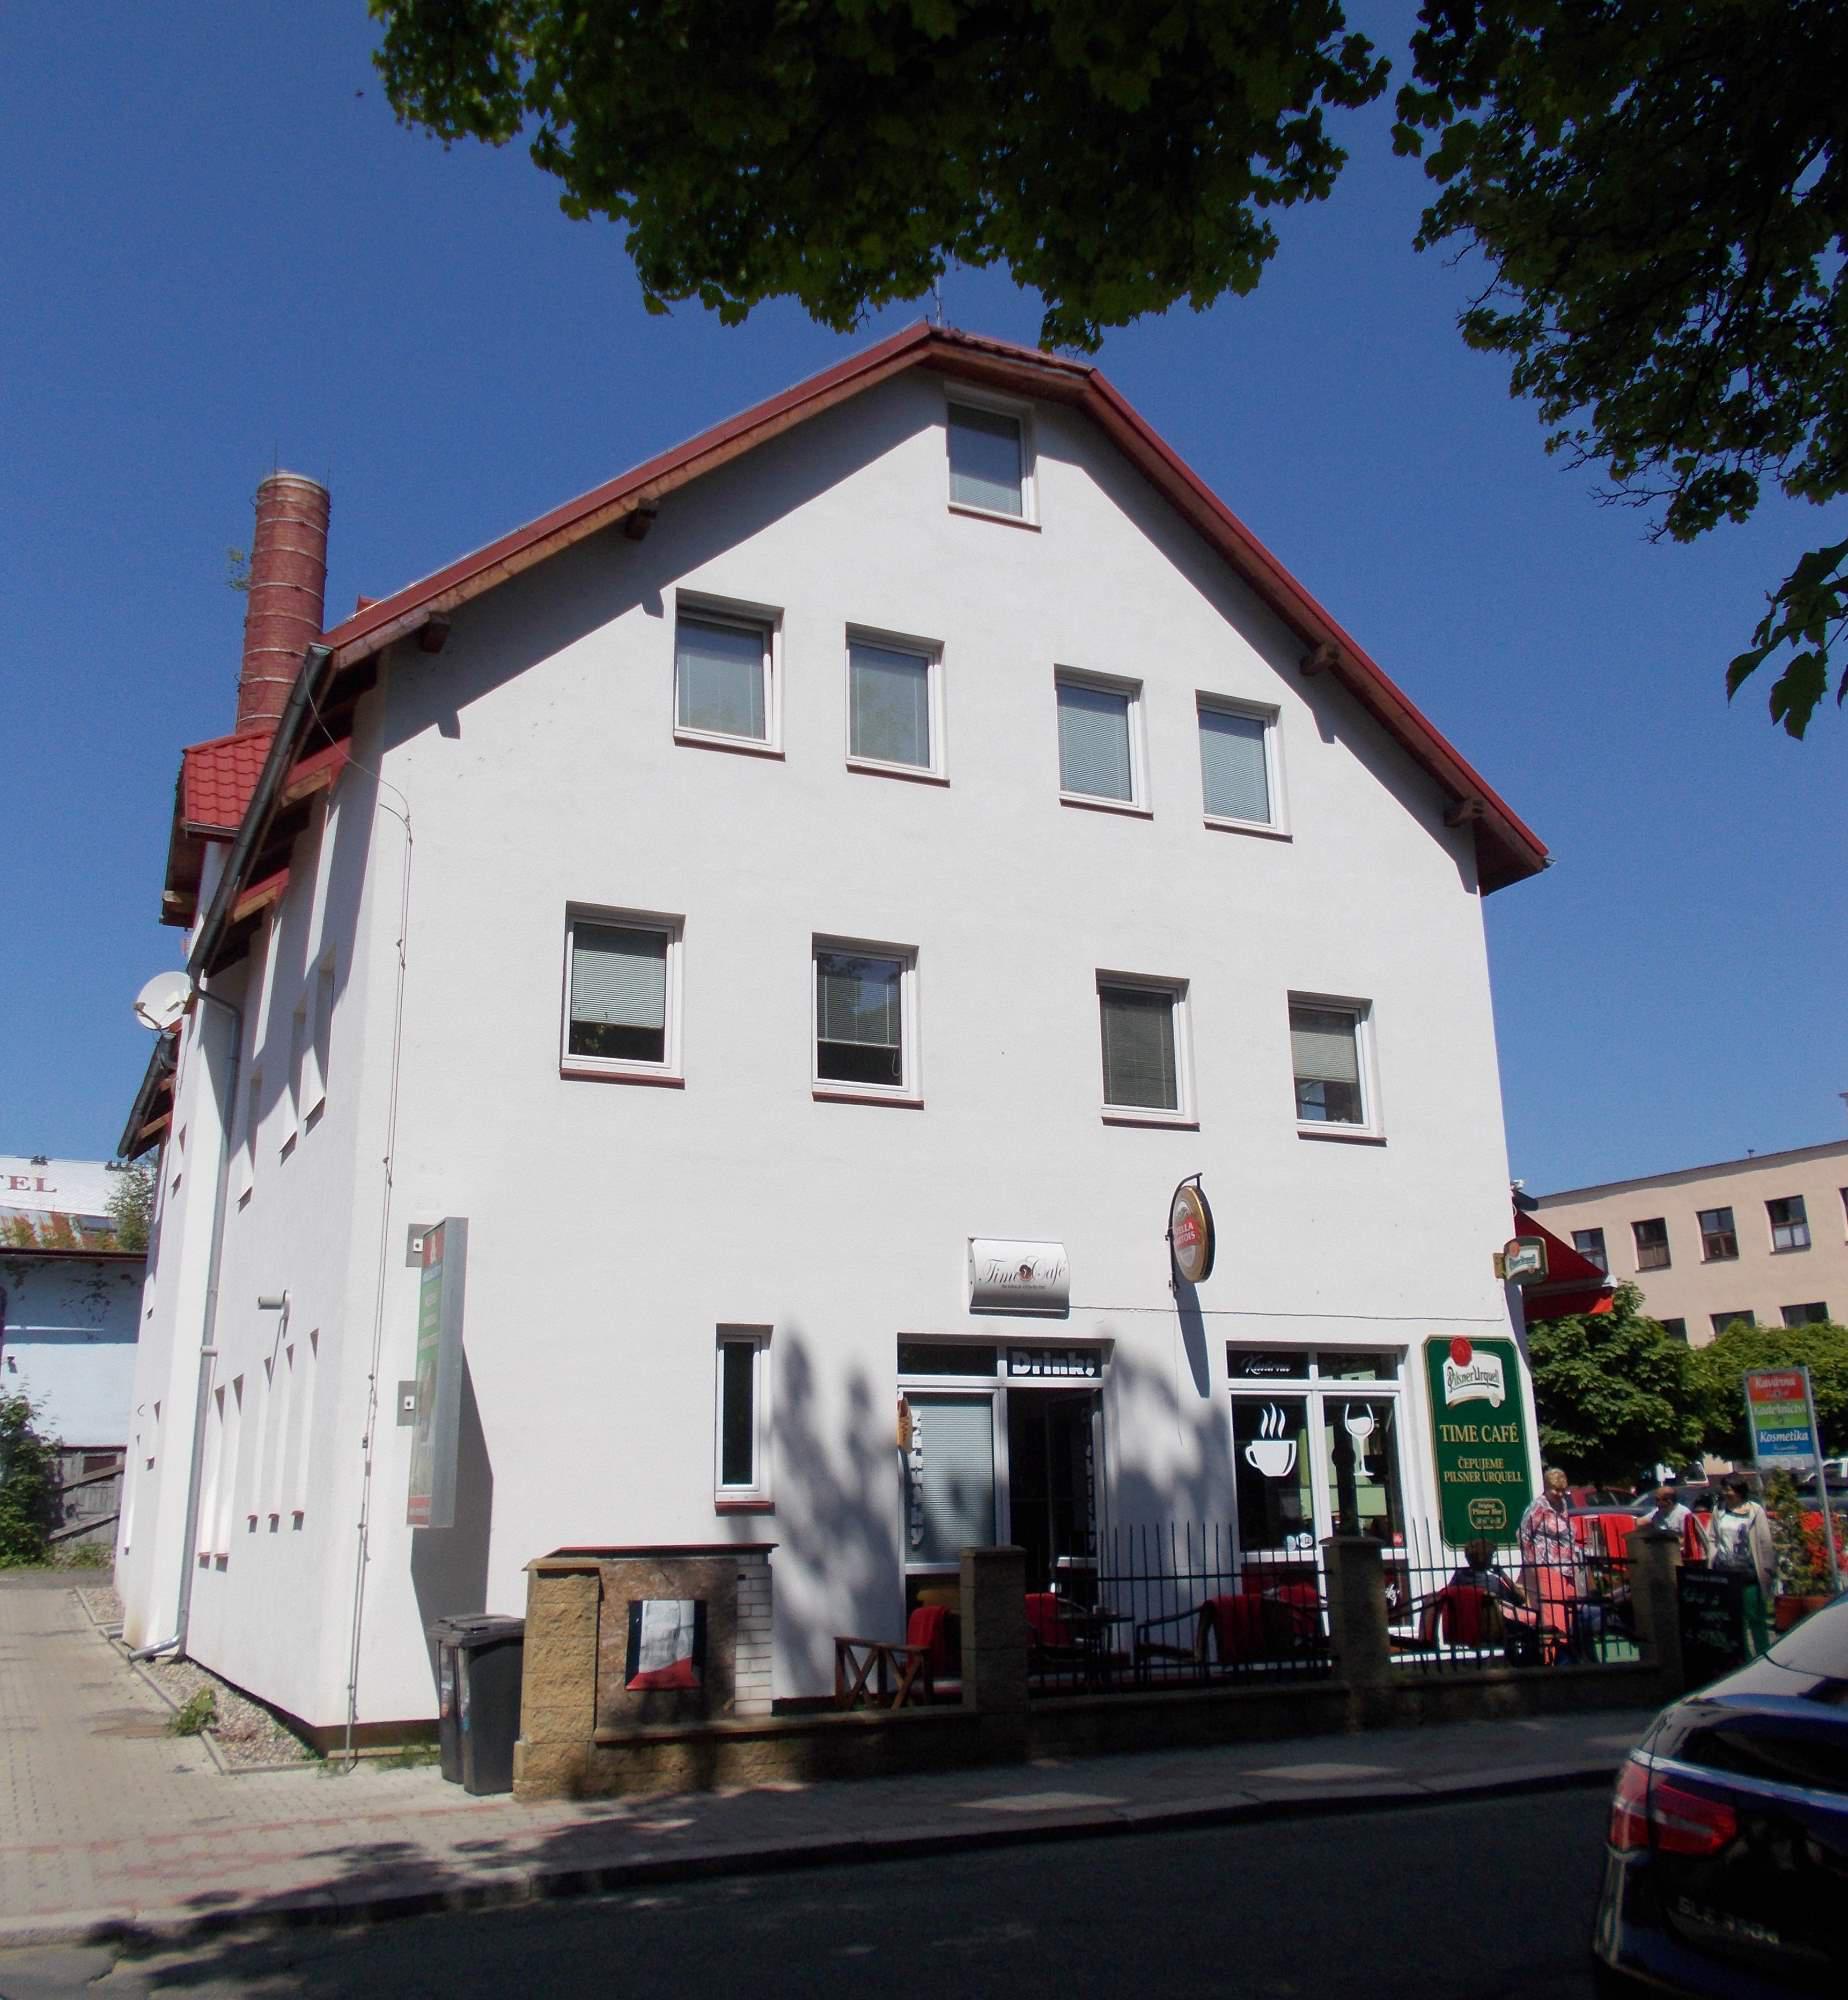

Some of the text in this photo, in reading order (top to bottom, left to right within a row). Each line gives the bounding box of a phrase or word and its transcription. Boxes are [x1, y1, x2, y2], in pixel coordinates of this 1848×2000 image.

[0, 1175, 57, 1193] EL
[985, 1255, 1066, 1288] Time Café
[1011, 1351, 1096, 1377] Drinks
[1447, 1365, 1500, 1393] Pilsner Urquell
[1440, 1422, 1520, 1443] TIME CAFÉ
[1760, 1429, 1809, 1443] Kosmetika
[1457, 1456, 1504, 1470] ČEPUJEME
[1444, 1471, 1524, 1485] PILSNER URQUELL
